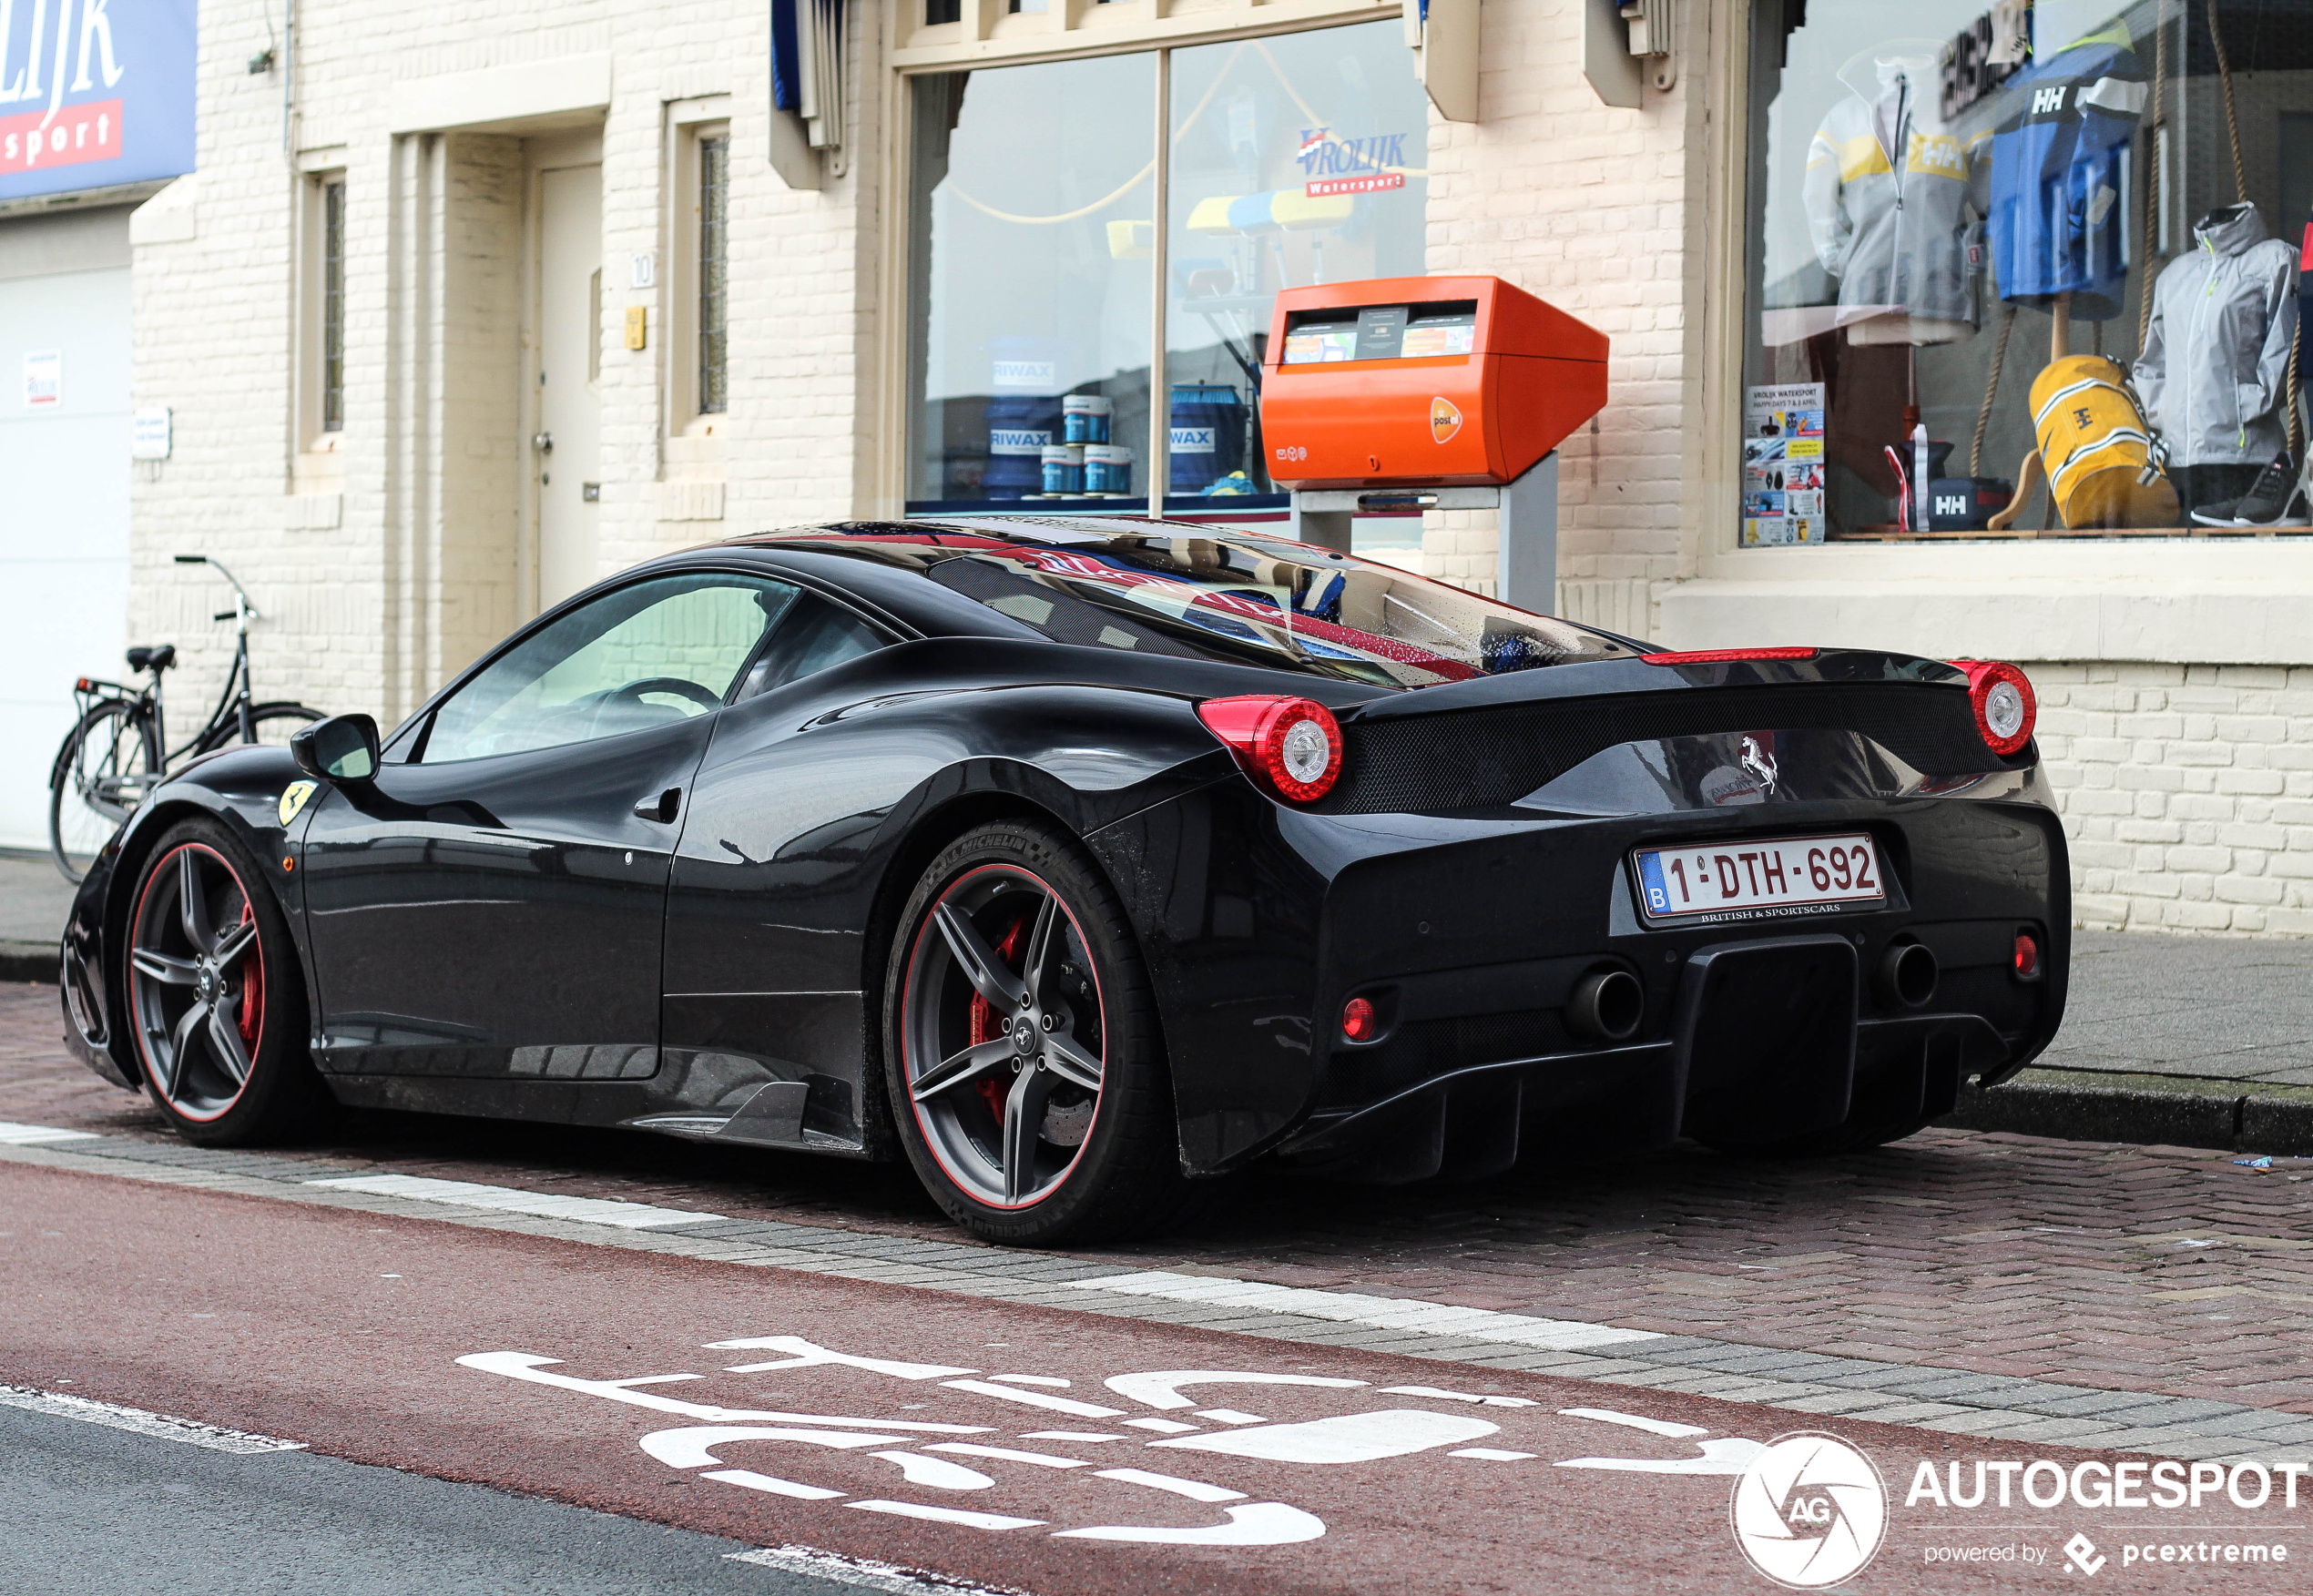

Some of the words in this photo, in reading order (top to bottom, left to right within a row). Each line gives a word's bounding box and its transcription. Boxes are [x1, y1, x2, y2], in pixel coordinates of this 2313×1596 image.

[2032, 86, 2066, 115] HH
[1297, 127, 1407, 178] VROLIJK
[1921, 141, 1963, 171] HH
[1309, 175, 1401, 192] Watersport
[993, 364, 1051, 379] RIWAX
[1778, 389, 1817, 397] WATERSPORT
[991, 432, 1048, 446] RIWAX
[1935, 495, 1967, 516] HH
[960, 834, 1026, 856] MICHELIN
[1649, 888, 1666, 909] B
[1671, 845, 1876, 903] 1-DTH-692
[1701, 910, 1754, 923] BRITISH
[1755, 910, 1765, 918] &
[1766, 904, 1841, 917] SPORTSCARS
